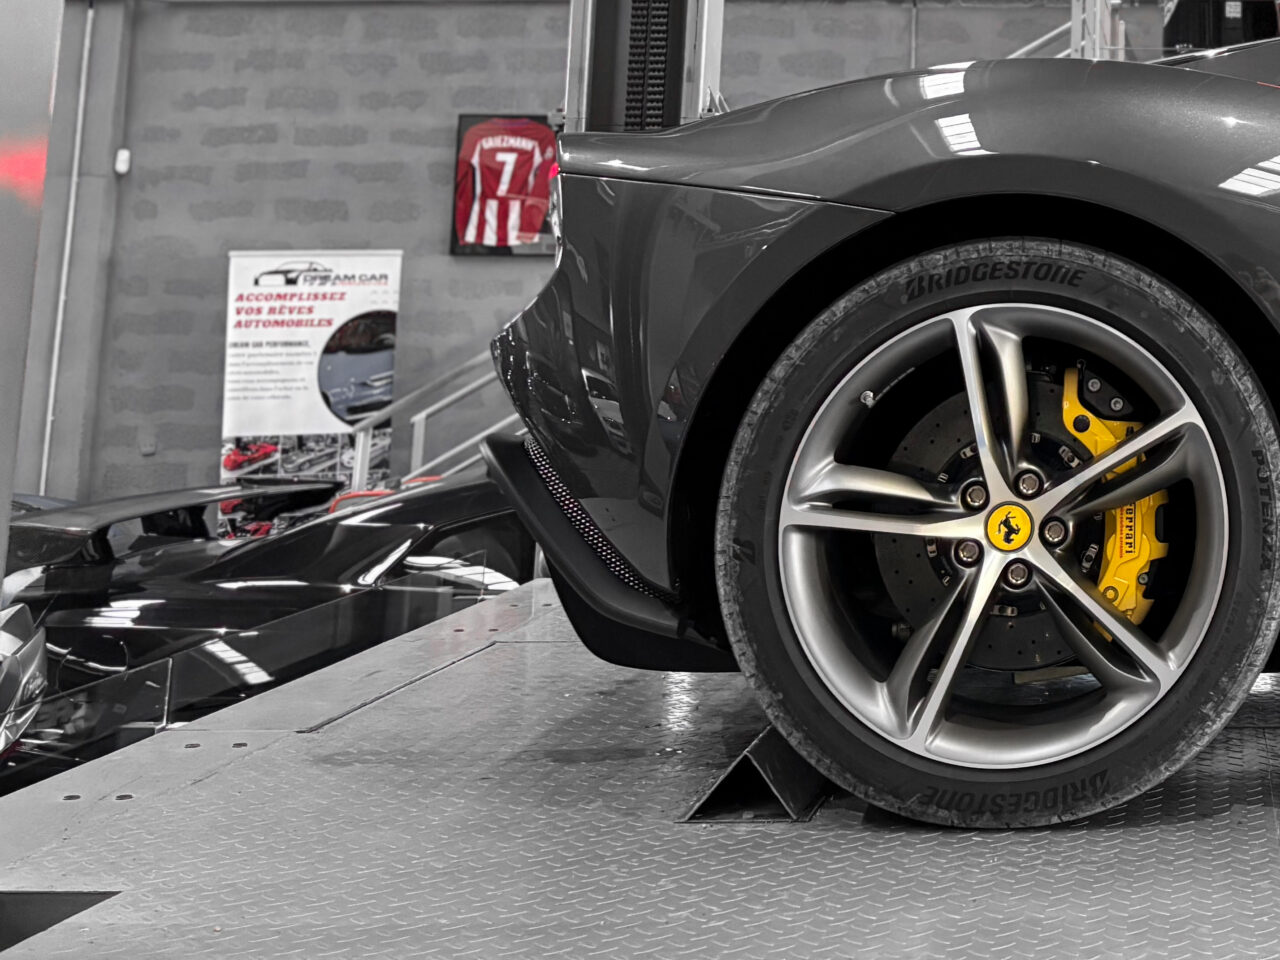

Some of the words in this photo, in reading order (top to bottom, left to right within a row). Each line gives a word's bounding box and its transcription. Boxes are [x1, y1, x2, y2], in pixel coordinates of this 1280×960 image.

[495, 152, 518, 196] 7
[235, 292, 346, 302] ACCOMPLISSEZ
[359, 274, 389, 282] CAR
[905, 261, 1087, 303] BRIDGESTONE
[234, 319, 333, 328] AUTOMOBILES
[235, 306, 263, 315] VOS
[267, 305, 314, 315] RÊVES
[1125, 503, 1136, 554] errari
[1251, 450, 1273, 571] POTENZA
[919, 769, 1110, 816] BRIDGESTONE
